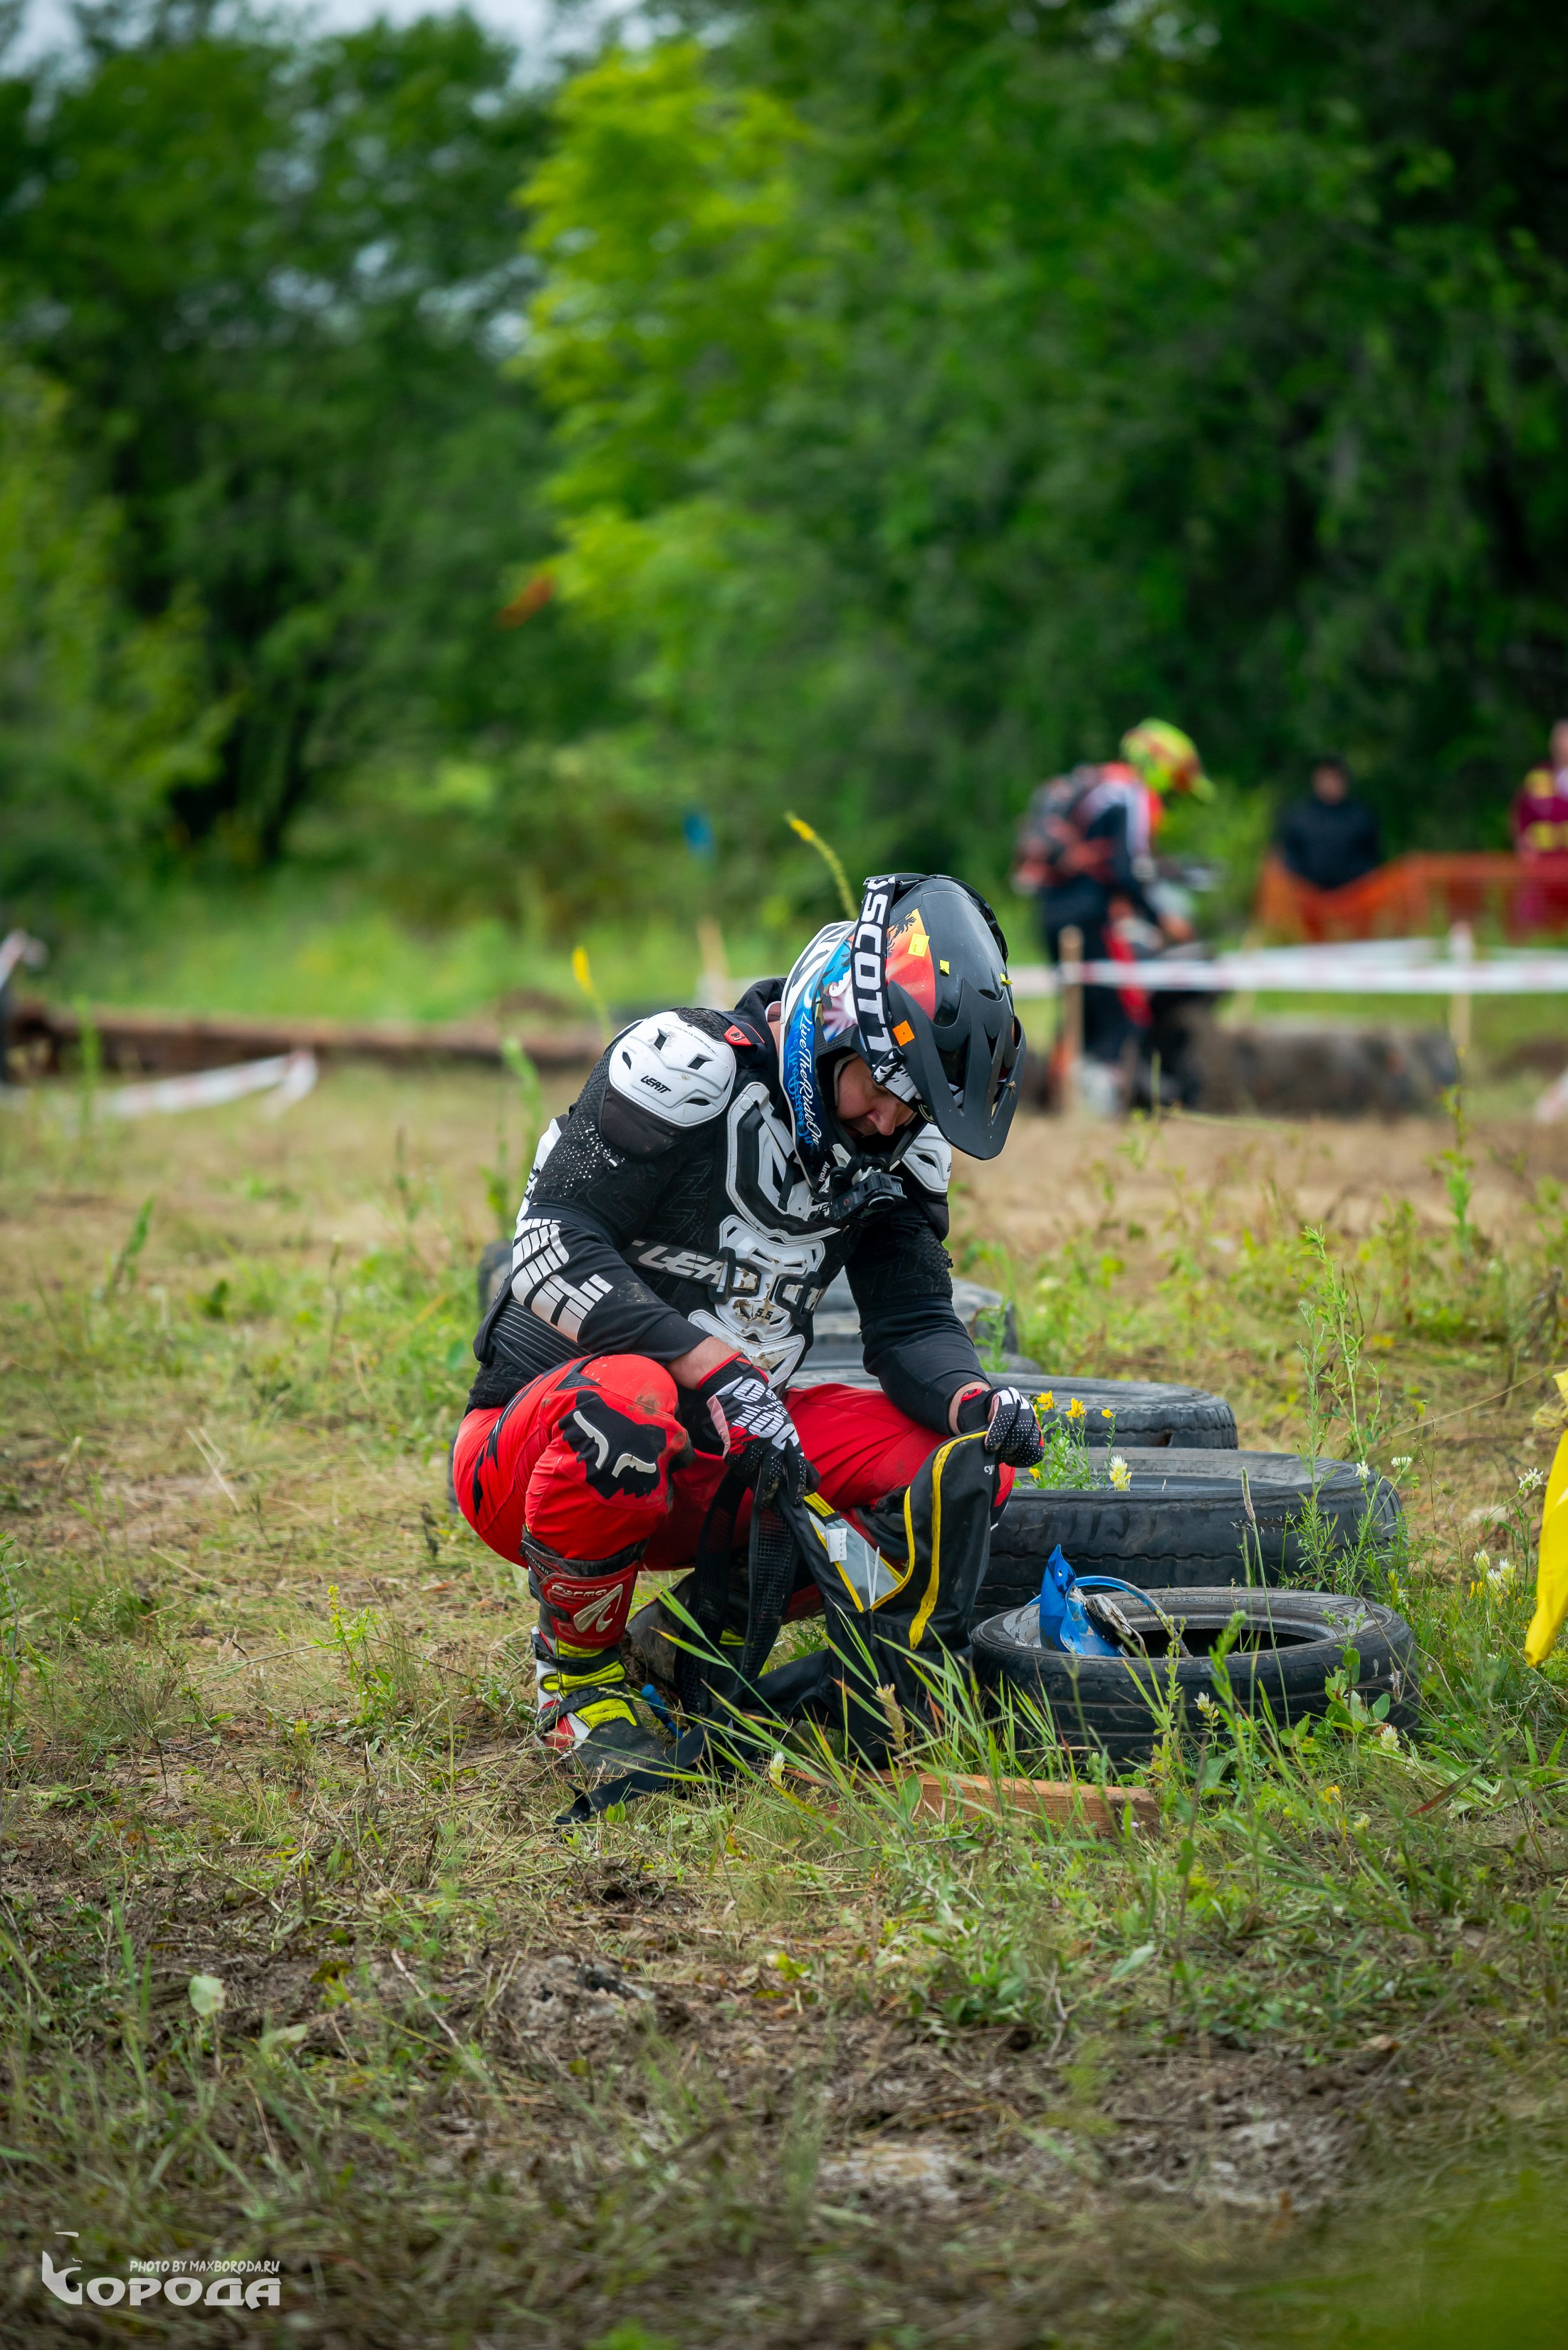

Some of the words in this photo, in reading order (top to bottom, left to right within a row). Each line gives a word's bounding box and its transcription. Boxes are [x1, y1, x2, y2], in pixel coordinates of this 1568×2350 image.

[640, 1075, 671, 1094] LEATT
[819, 1161, 831, 1182] Airoh
[755, 1307, 773, 1321] 5.5
